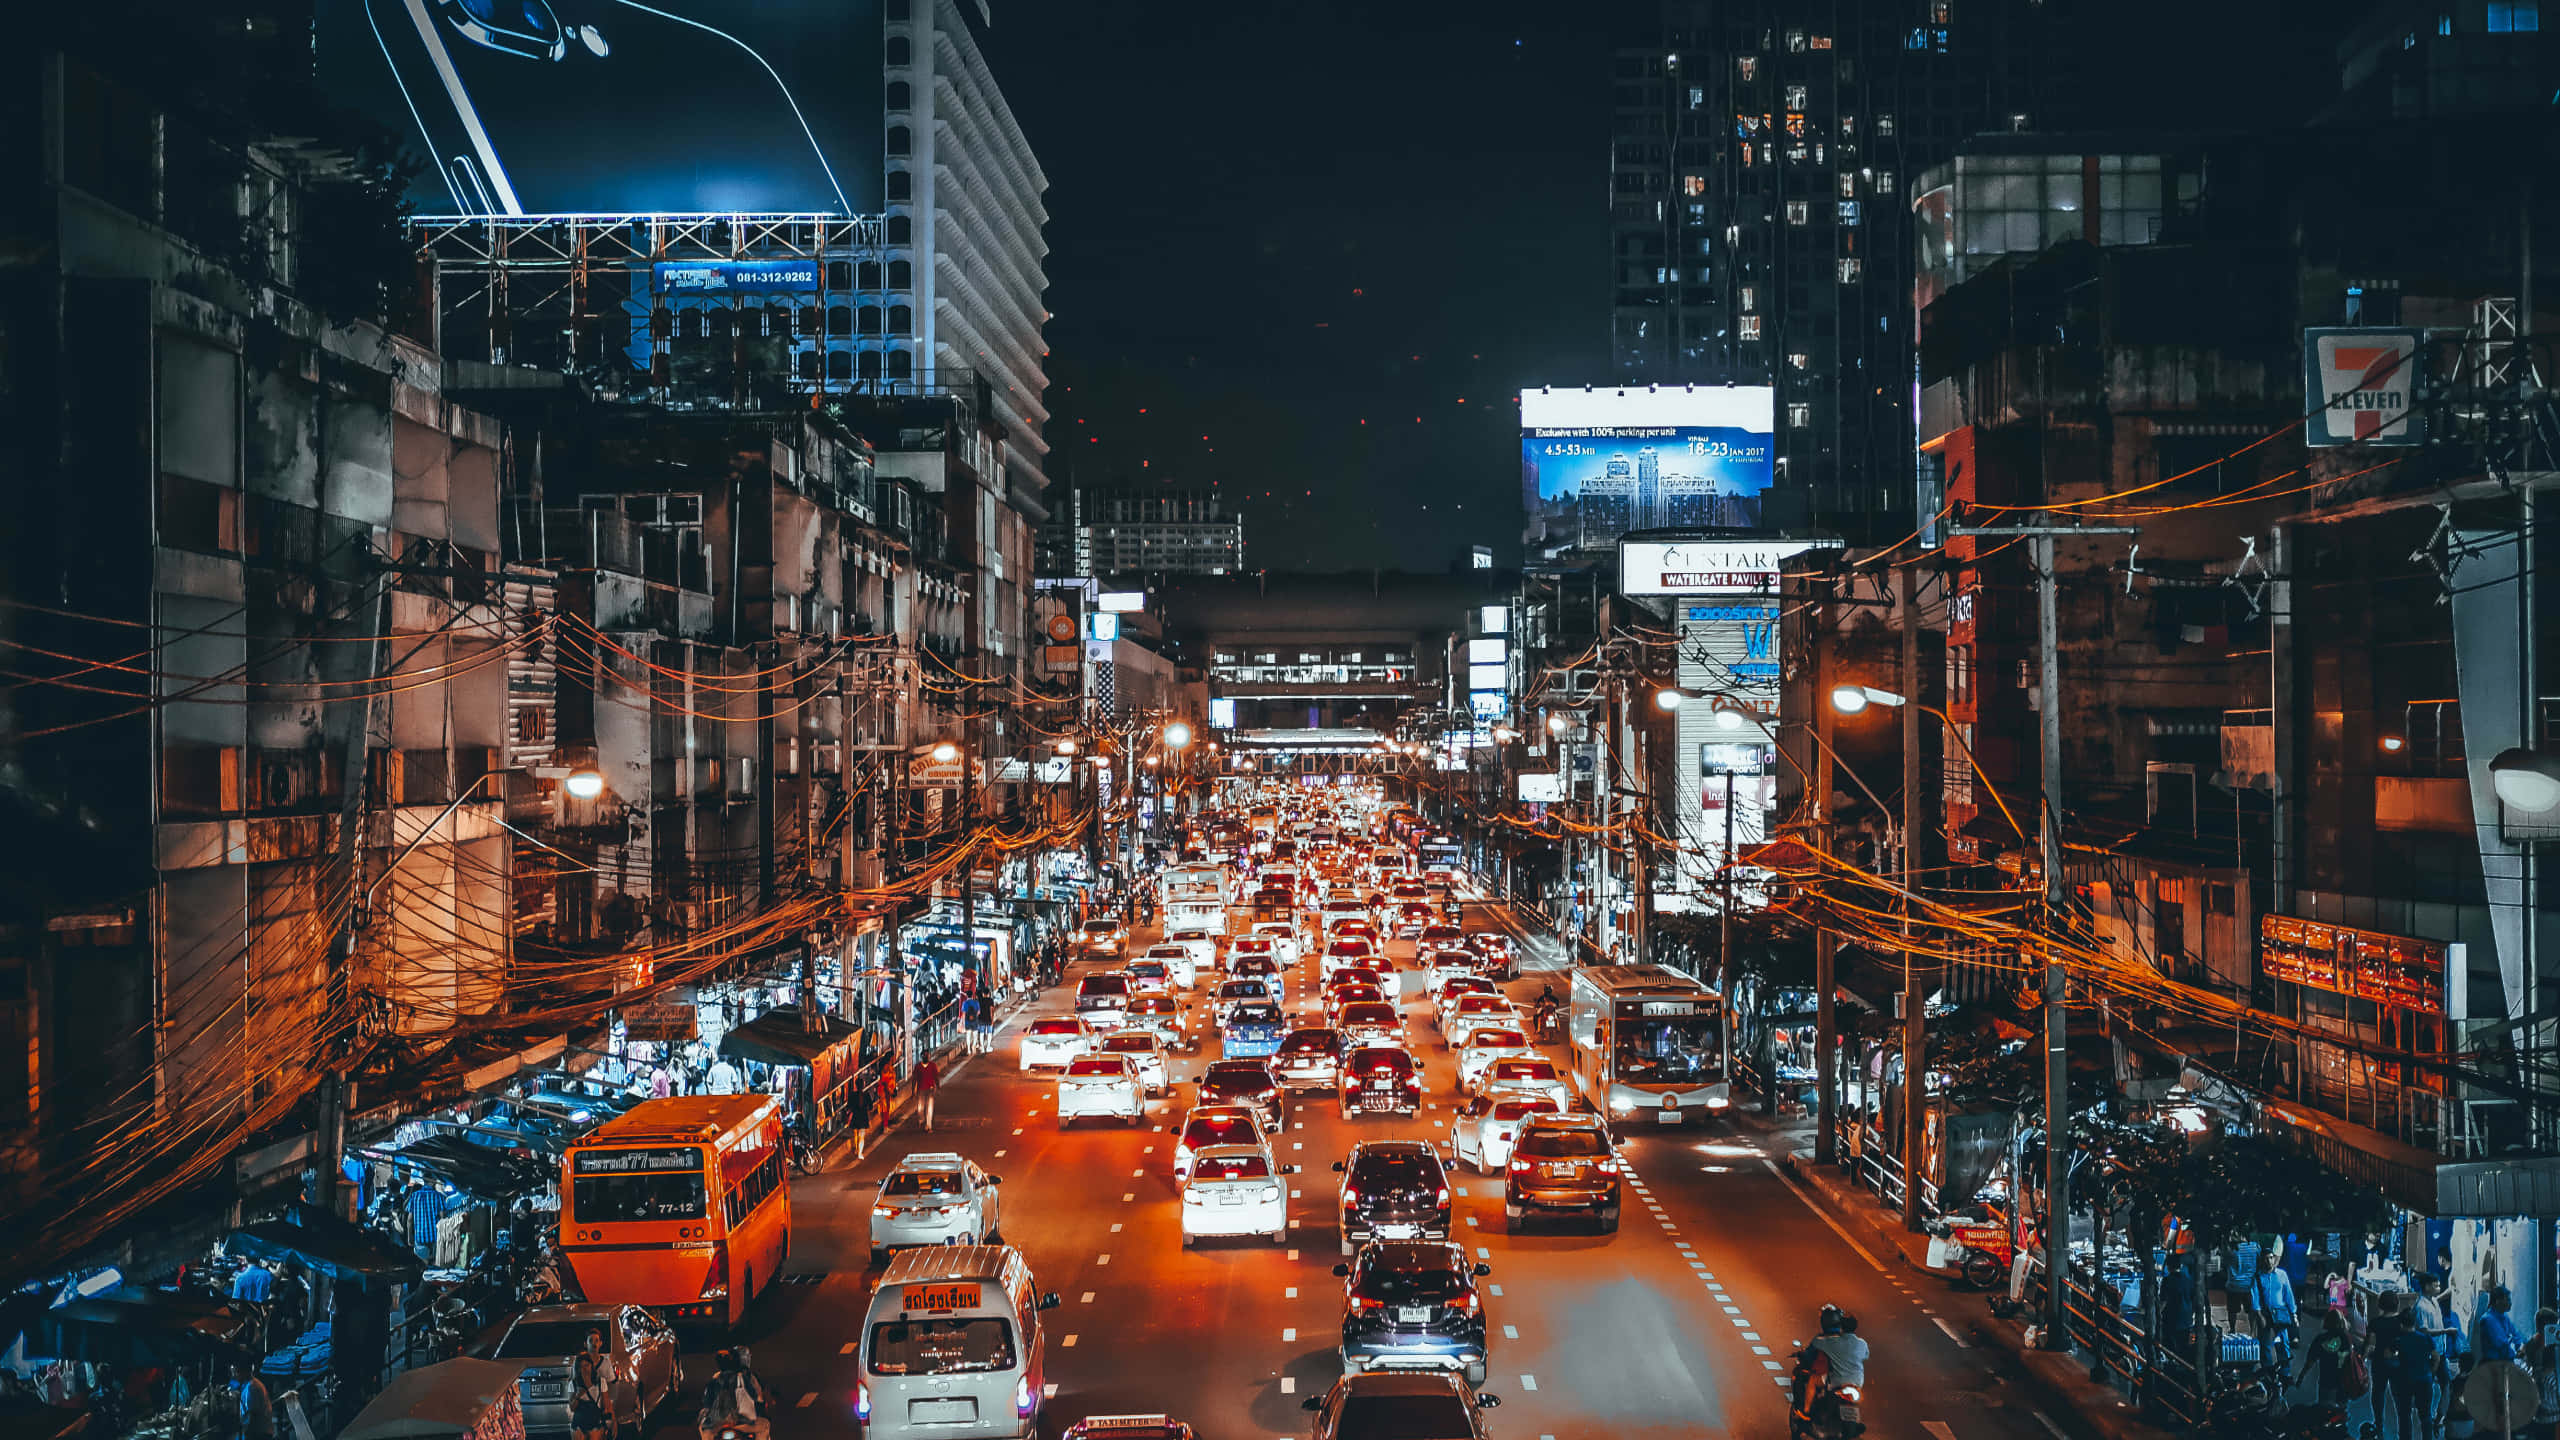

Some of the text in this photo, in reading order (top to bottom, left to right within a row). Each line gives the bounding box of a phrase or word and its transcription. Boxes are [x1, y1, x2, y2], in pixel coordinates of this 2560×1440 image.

[1591, 428, 1616, 437] 100%
[1616, 428, 1646, 439] parking
[1646, 429, 1660, 439] per
[1545, 444, 1581, 456] 4.5-53
[1687, 442, 1765, 457] 18-23 JAN 2017
[1666, 573, 1780, 586] WATERGATE PAVILO
[628, 1152, 649, 1169] 77
[658, 1202, 695, 1213] 77-12
